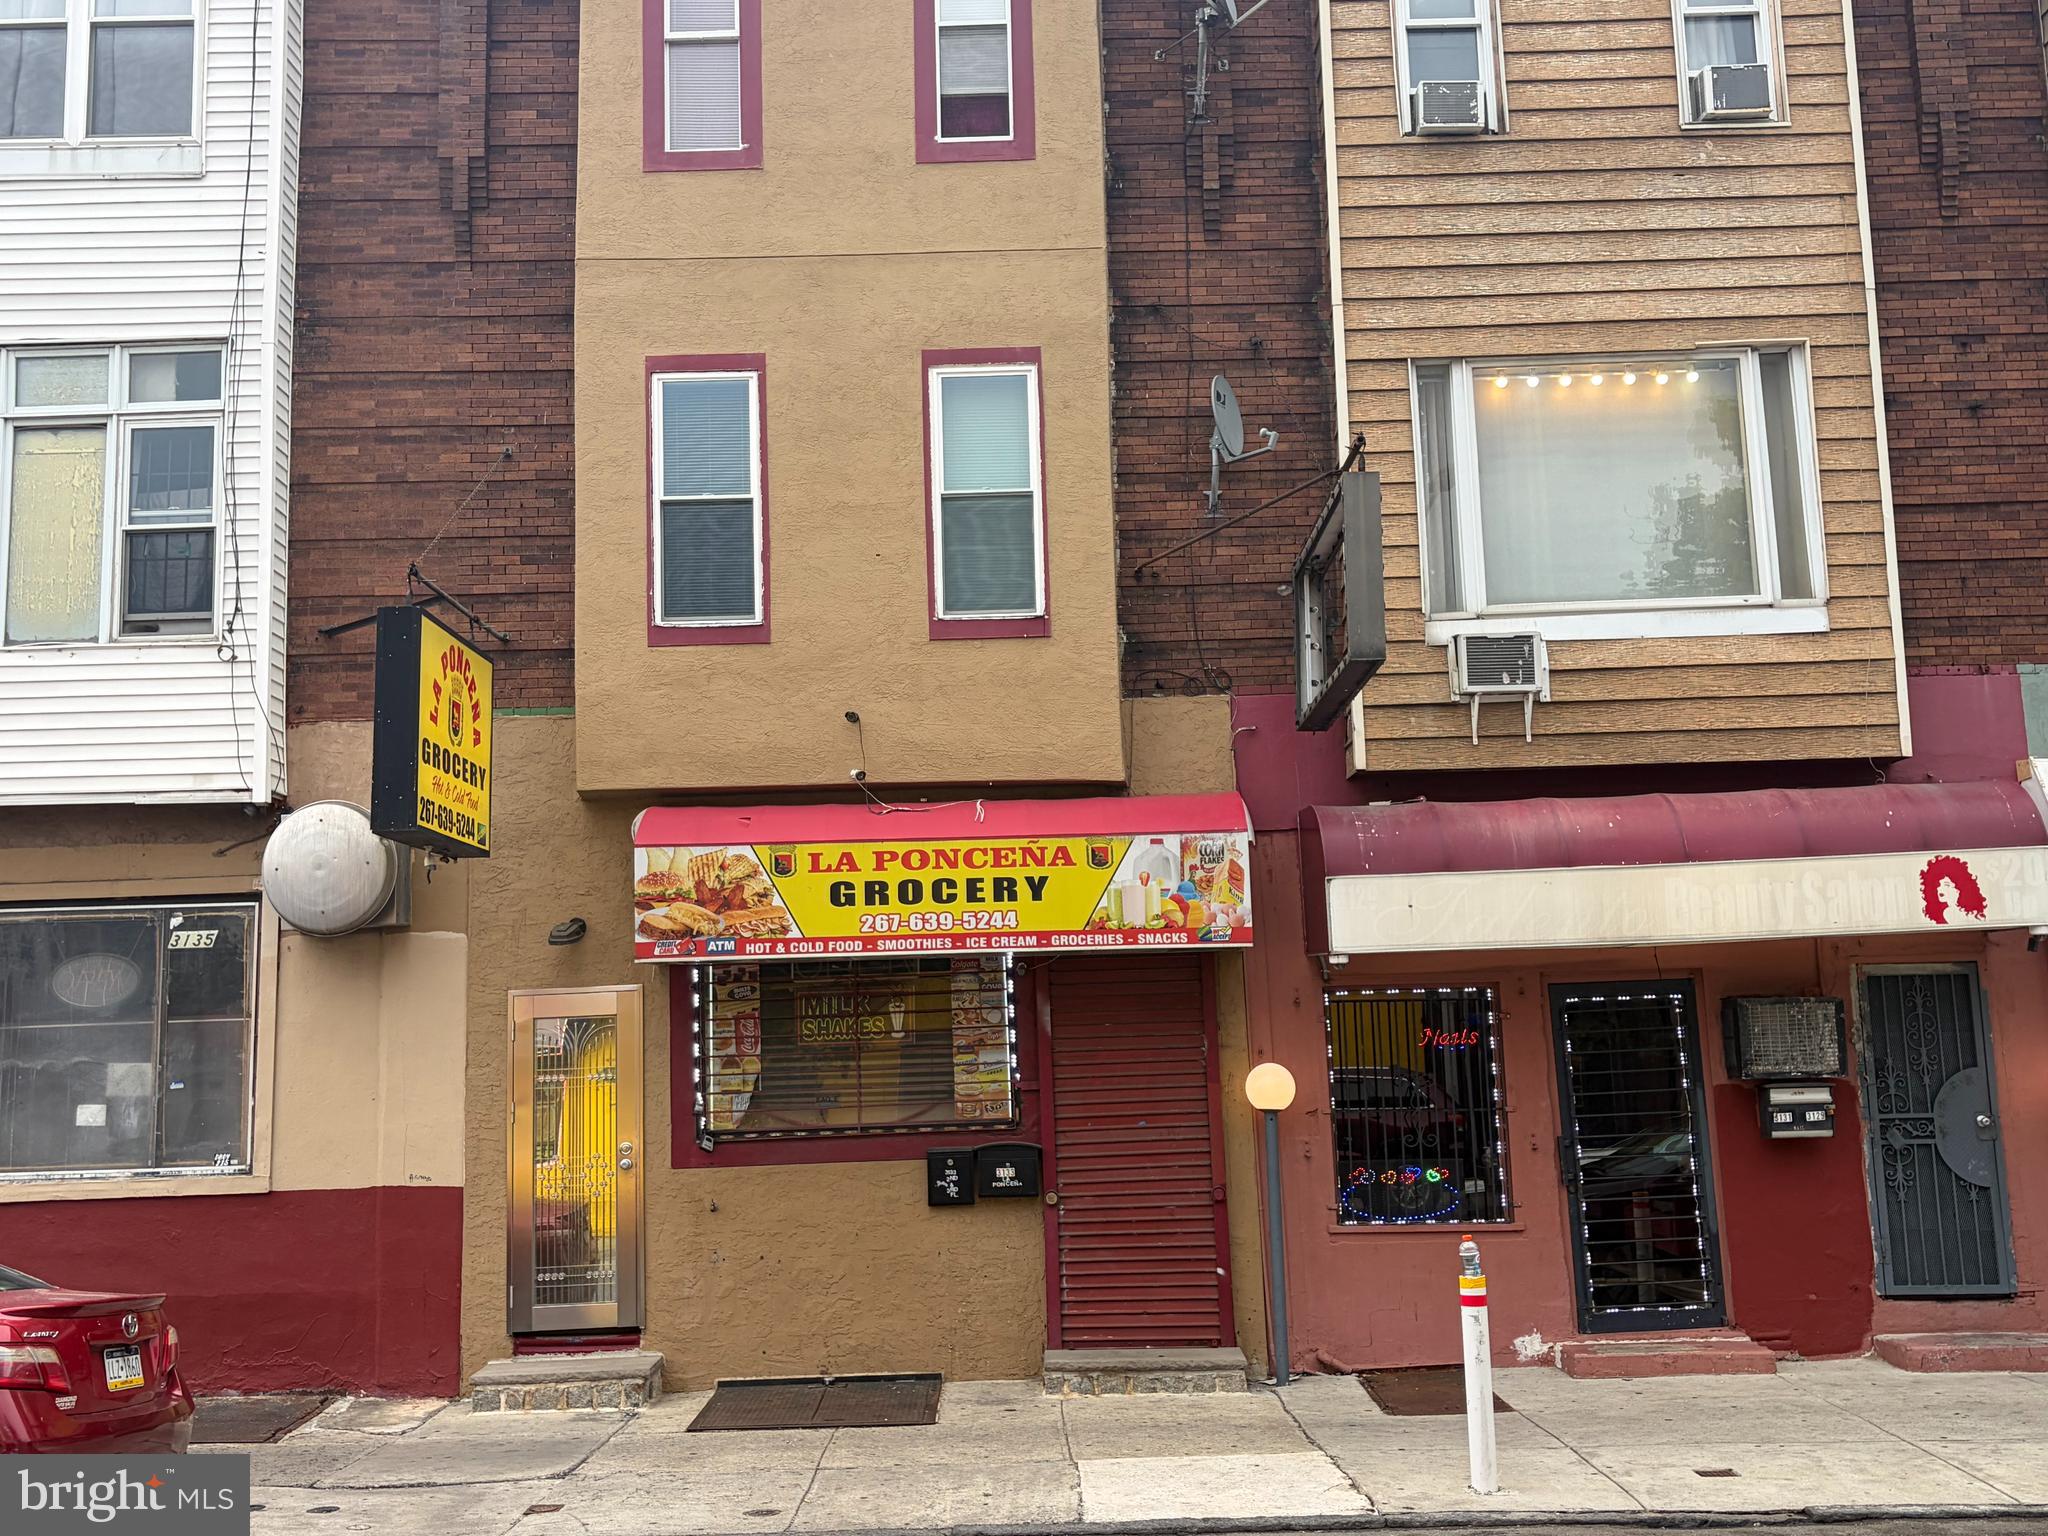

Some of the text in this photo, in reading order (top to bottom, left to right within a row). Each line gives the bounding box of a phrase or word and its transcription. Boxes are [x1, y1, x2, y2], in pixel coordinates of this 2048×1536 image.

[430, 678, 442, 727] LA
[422, 737, 487, 792] GROCERY
[432, 775, 480, 812] Hot & Cold Food
[420, 796, 475, 841] 267-639-5244
[807, 839, 1077, 873] LA PONCEÑA
[1199, 843, 1225, 857] CORN
[1200, 856, 1225, 865] FLAKES
[829, 876, 1050, 907] GROCERY
[859, 911, 1018, 934] 267-639-5244
[170, 933, 215, 948] 3135
[707, 941, 735, 952] ATM
[746, 943, 771, 954] HOT
[776, 942, 785, 953] &
[790, 941, 824, 953] COLD
[828, 940, 863, 952] FOOD
[877, 937, 952, 950] SMOOTHIES
[966, 937, 987, 948] ICE
[991, 935, 1037, 948] CREAM
[1051, 933, 1124, 946] GROCERIES
[1137, 932, 1188, 945] SNACKS
[802, 994, 871, 1016] MILK
[802, 1016, 886, 1041] SHAKES
[1418, 1028, 1480, 1046] Nails
[1806, 1111, 1825, 1121] 3129
